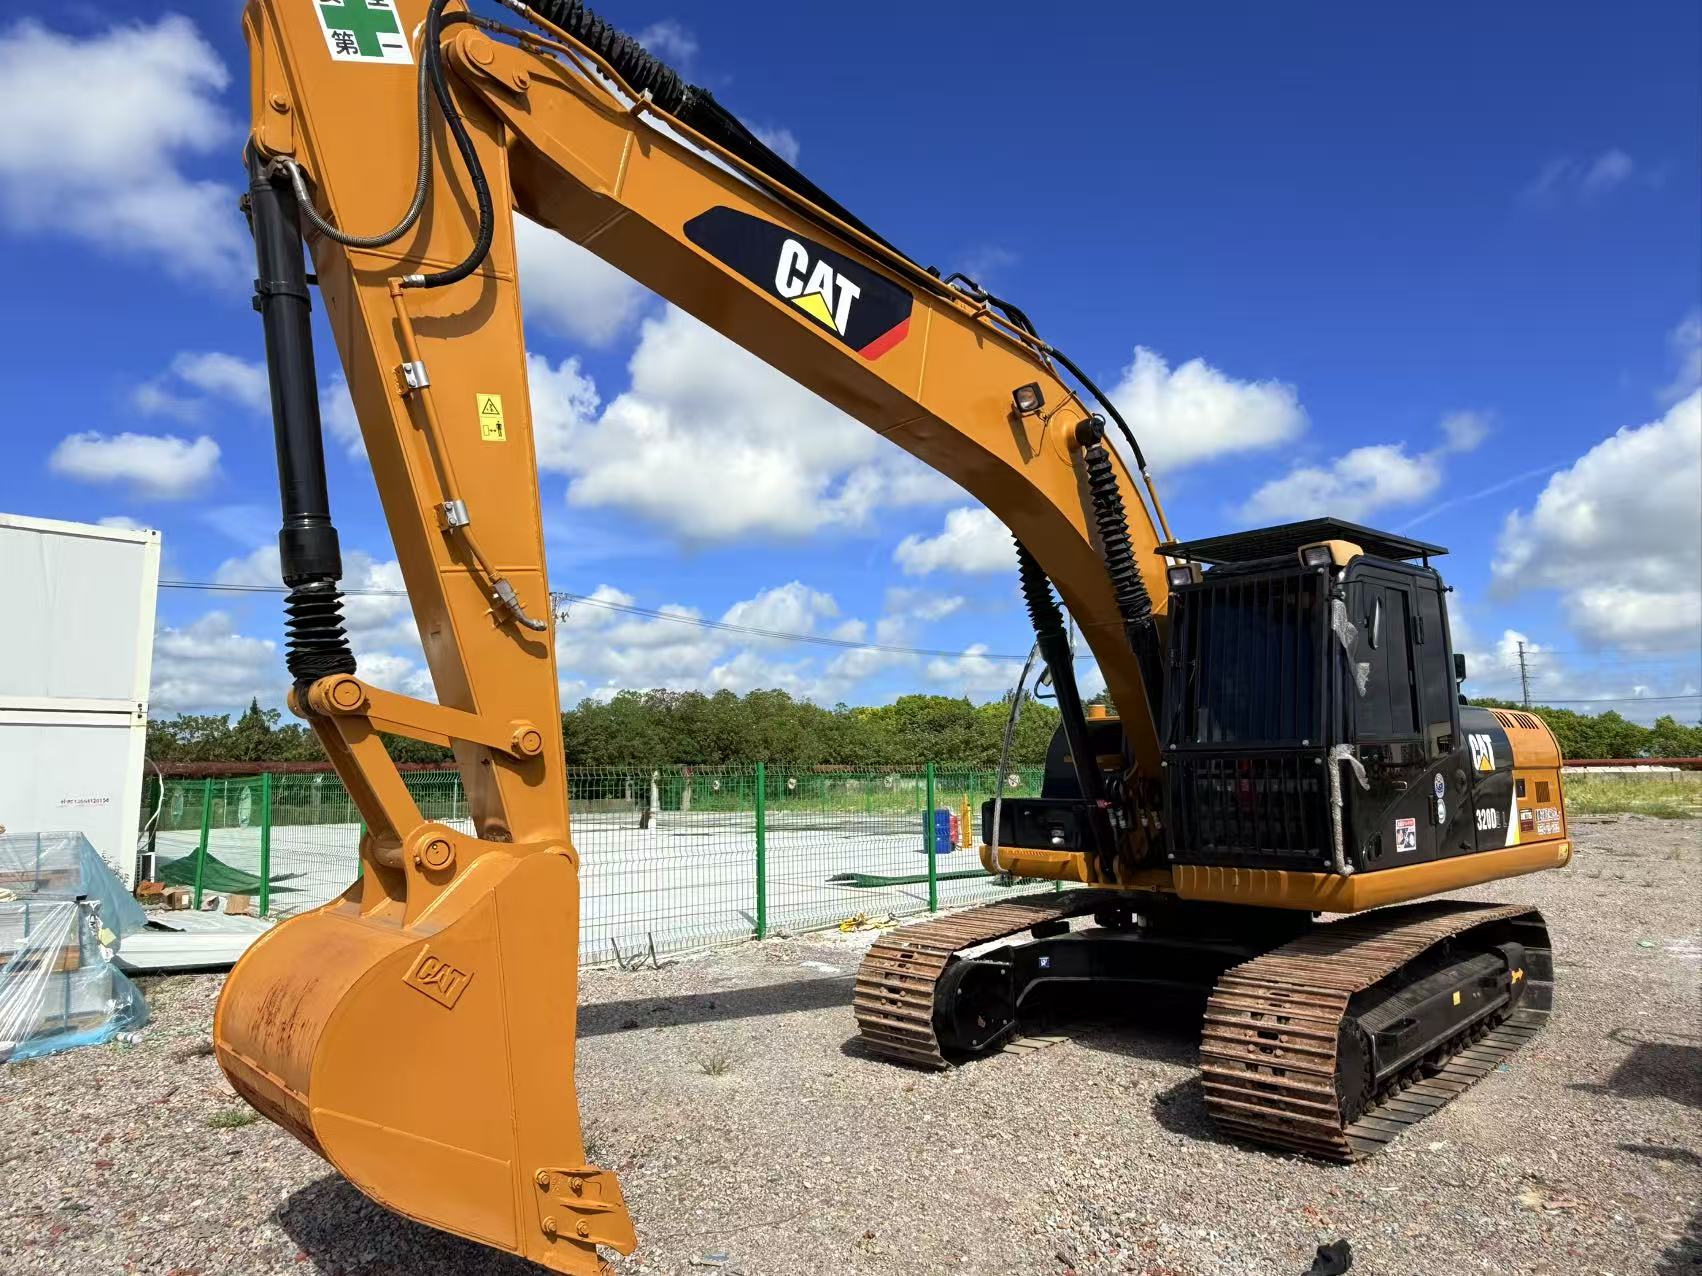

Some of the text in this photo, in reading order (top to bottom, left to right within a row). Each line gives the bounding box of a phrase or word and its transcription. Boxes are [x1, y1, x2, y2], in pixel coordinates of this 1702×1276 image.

[775, 238, 860, 337] CAT
[1468, 733, 1496, 771] CAT
[1475, 807, 1497, 831] 320D
[415, 955, 467, 997] CAT
